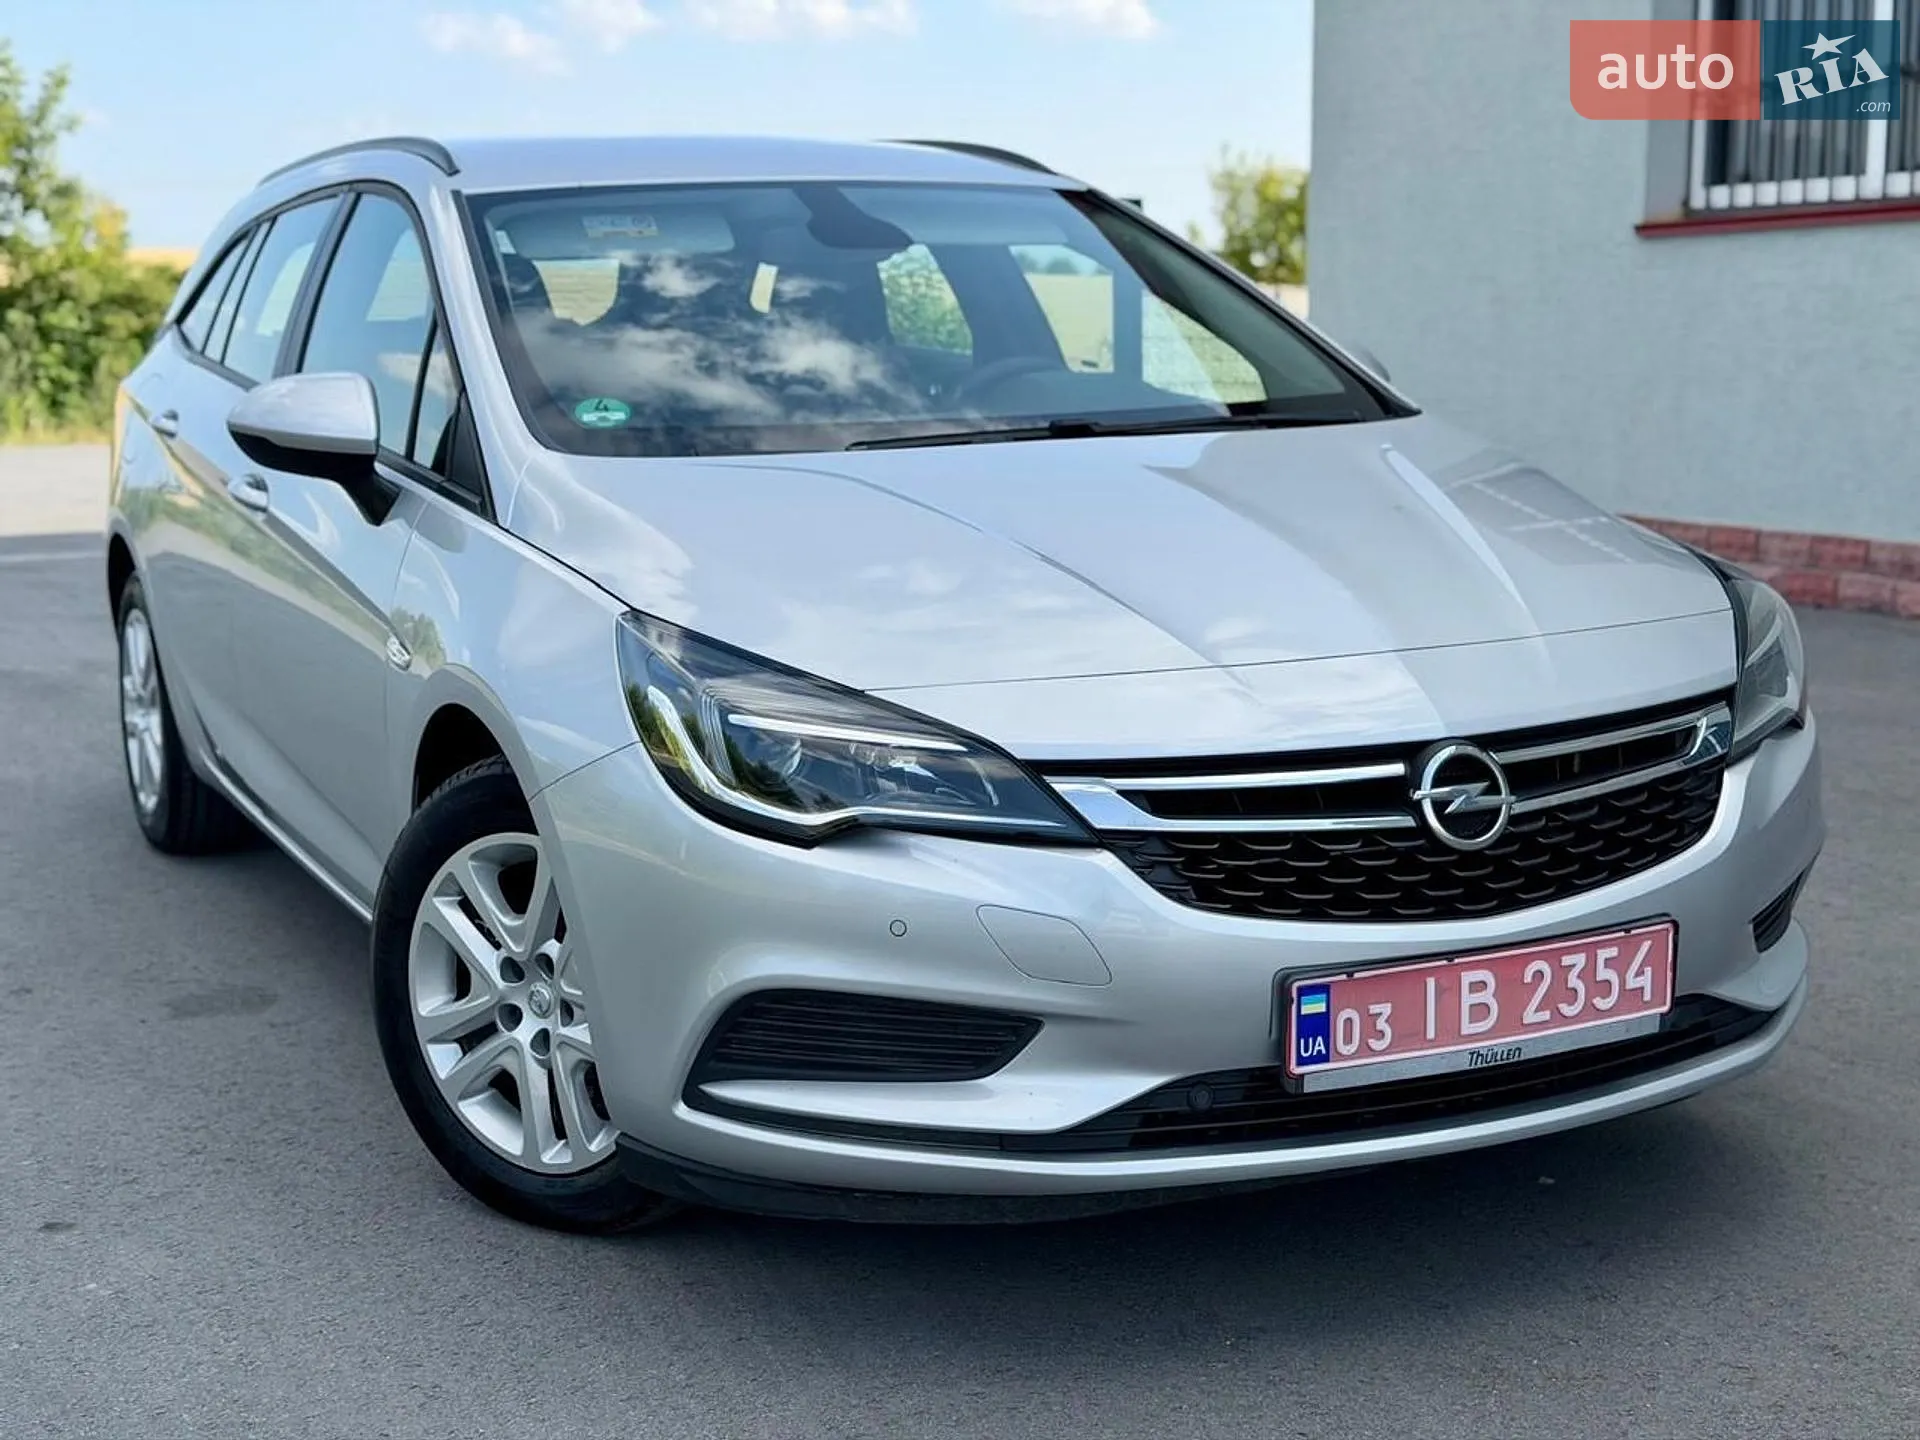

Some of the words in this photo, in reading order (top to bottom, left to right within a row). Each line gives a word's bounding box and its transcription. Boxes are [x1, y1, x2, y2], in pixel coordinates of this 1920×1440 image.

[1335, 1003, 1393, 1055] 03
[1522, 940, 1654, 1025] 2354
[1300, 1037, 1326, 1057] UA
